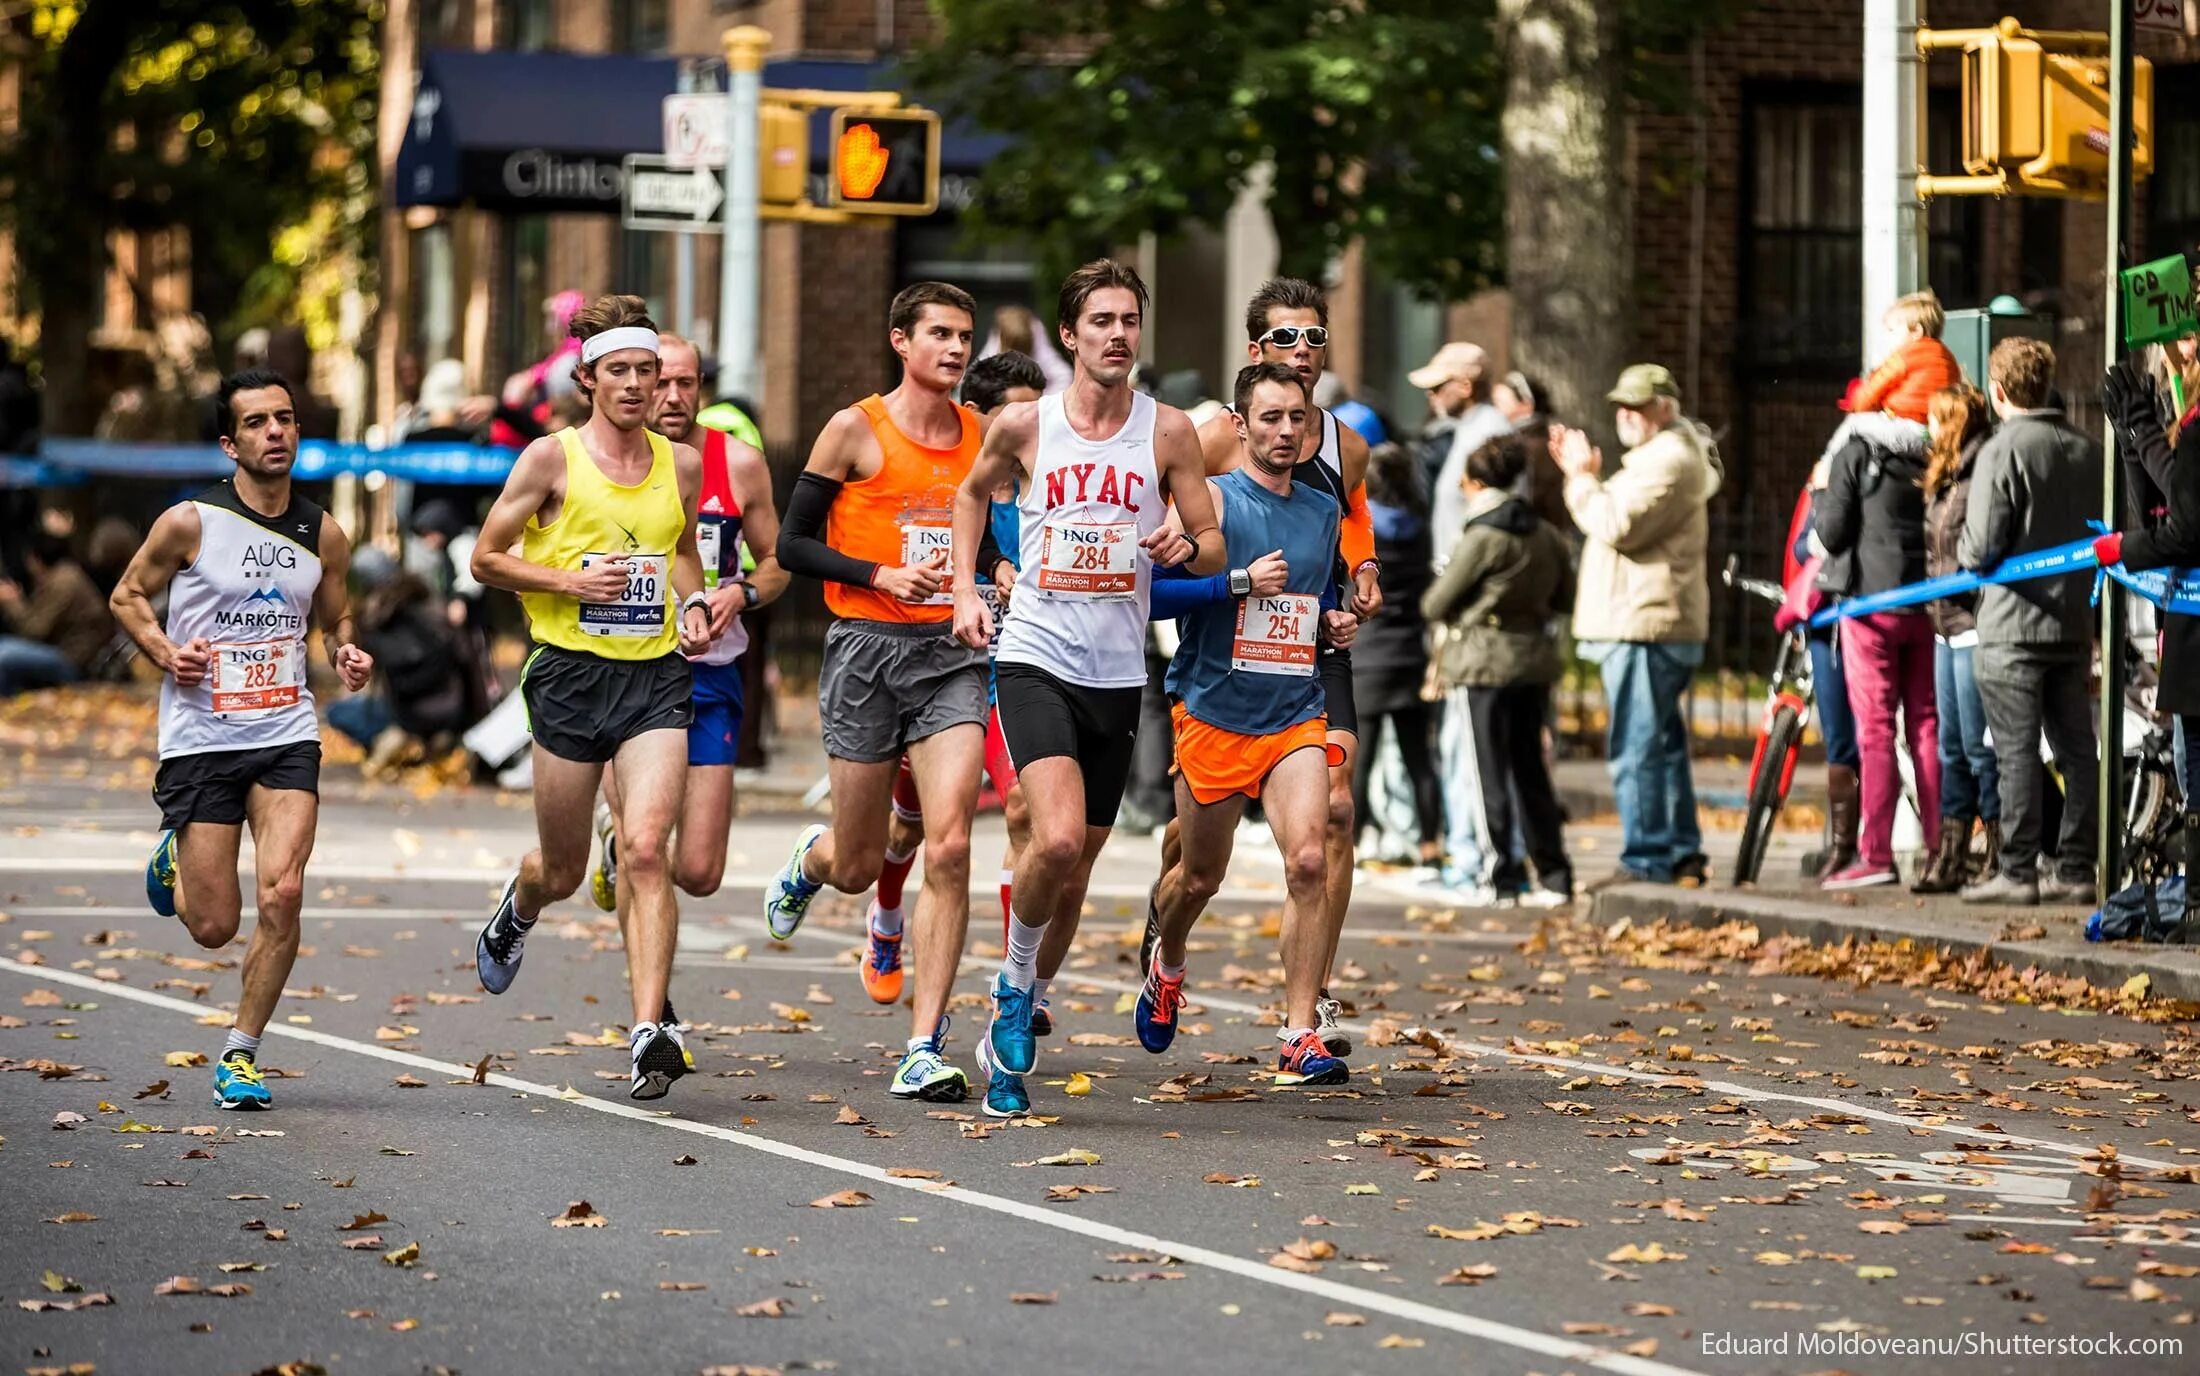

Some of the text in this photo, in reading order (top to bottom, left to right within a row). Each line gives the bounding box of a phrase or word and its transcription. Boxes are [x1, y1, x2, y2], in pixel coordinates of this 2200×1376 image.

[503, 150, 626, 200] Clinto
[1046, 463, 1144, 513] NYAC
[920, 532, 950, 545] ING
[1063, 529, 1099, 543] ING
[242, 542, 296, 569] AÜG
[1072, 545, 1110, 570] 284
[1046, 576, 1089, 585] MARATHON
[586, 610, 628, 618] MARATHON
[1258, 599, 1291, 613] ING
[1236, 609, 1245, 630] WAVE
[1267, 615, 1299, 640] 254
[232, 650, 266, 663] ING
[1240, 646, 1282, 656] MARATHON
[245, 663, 277, 688] 282
